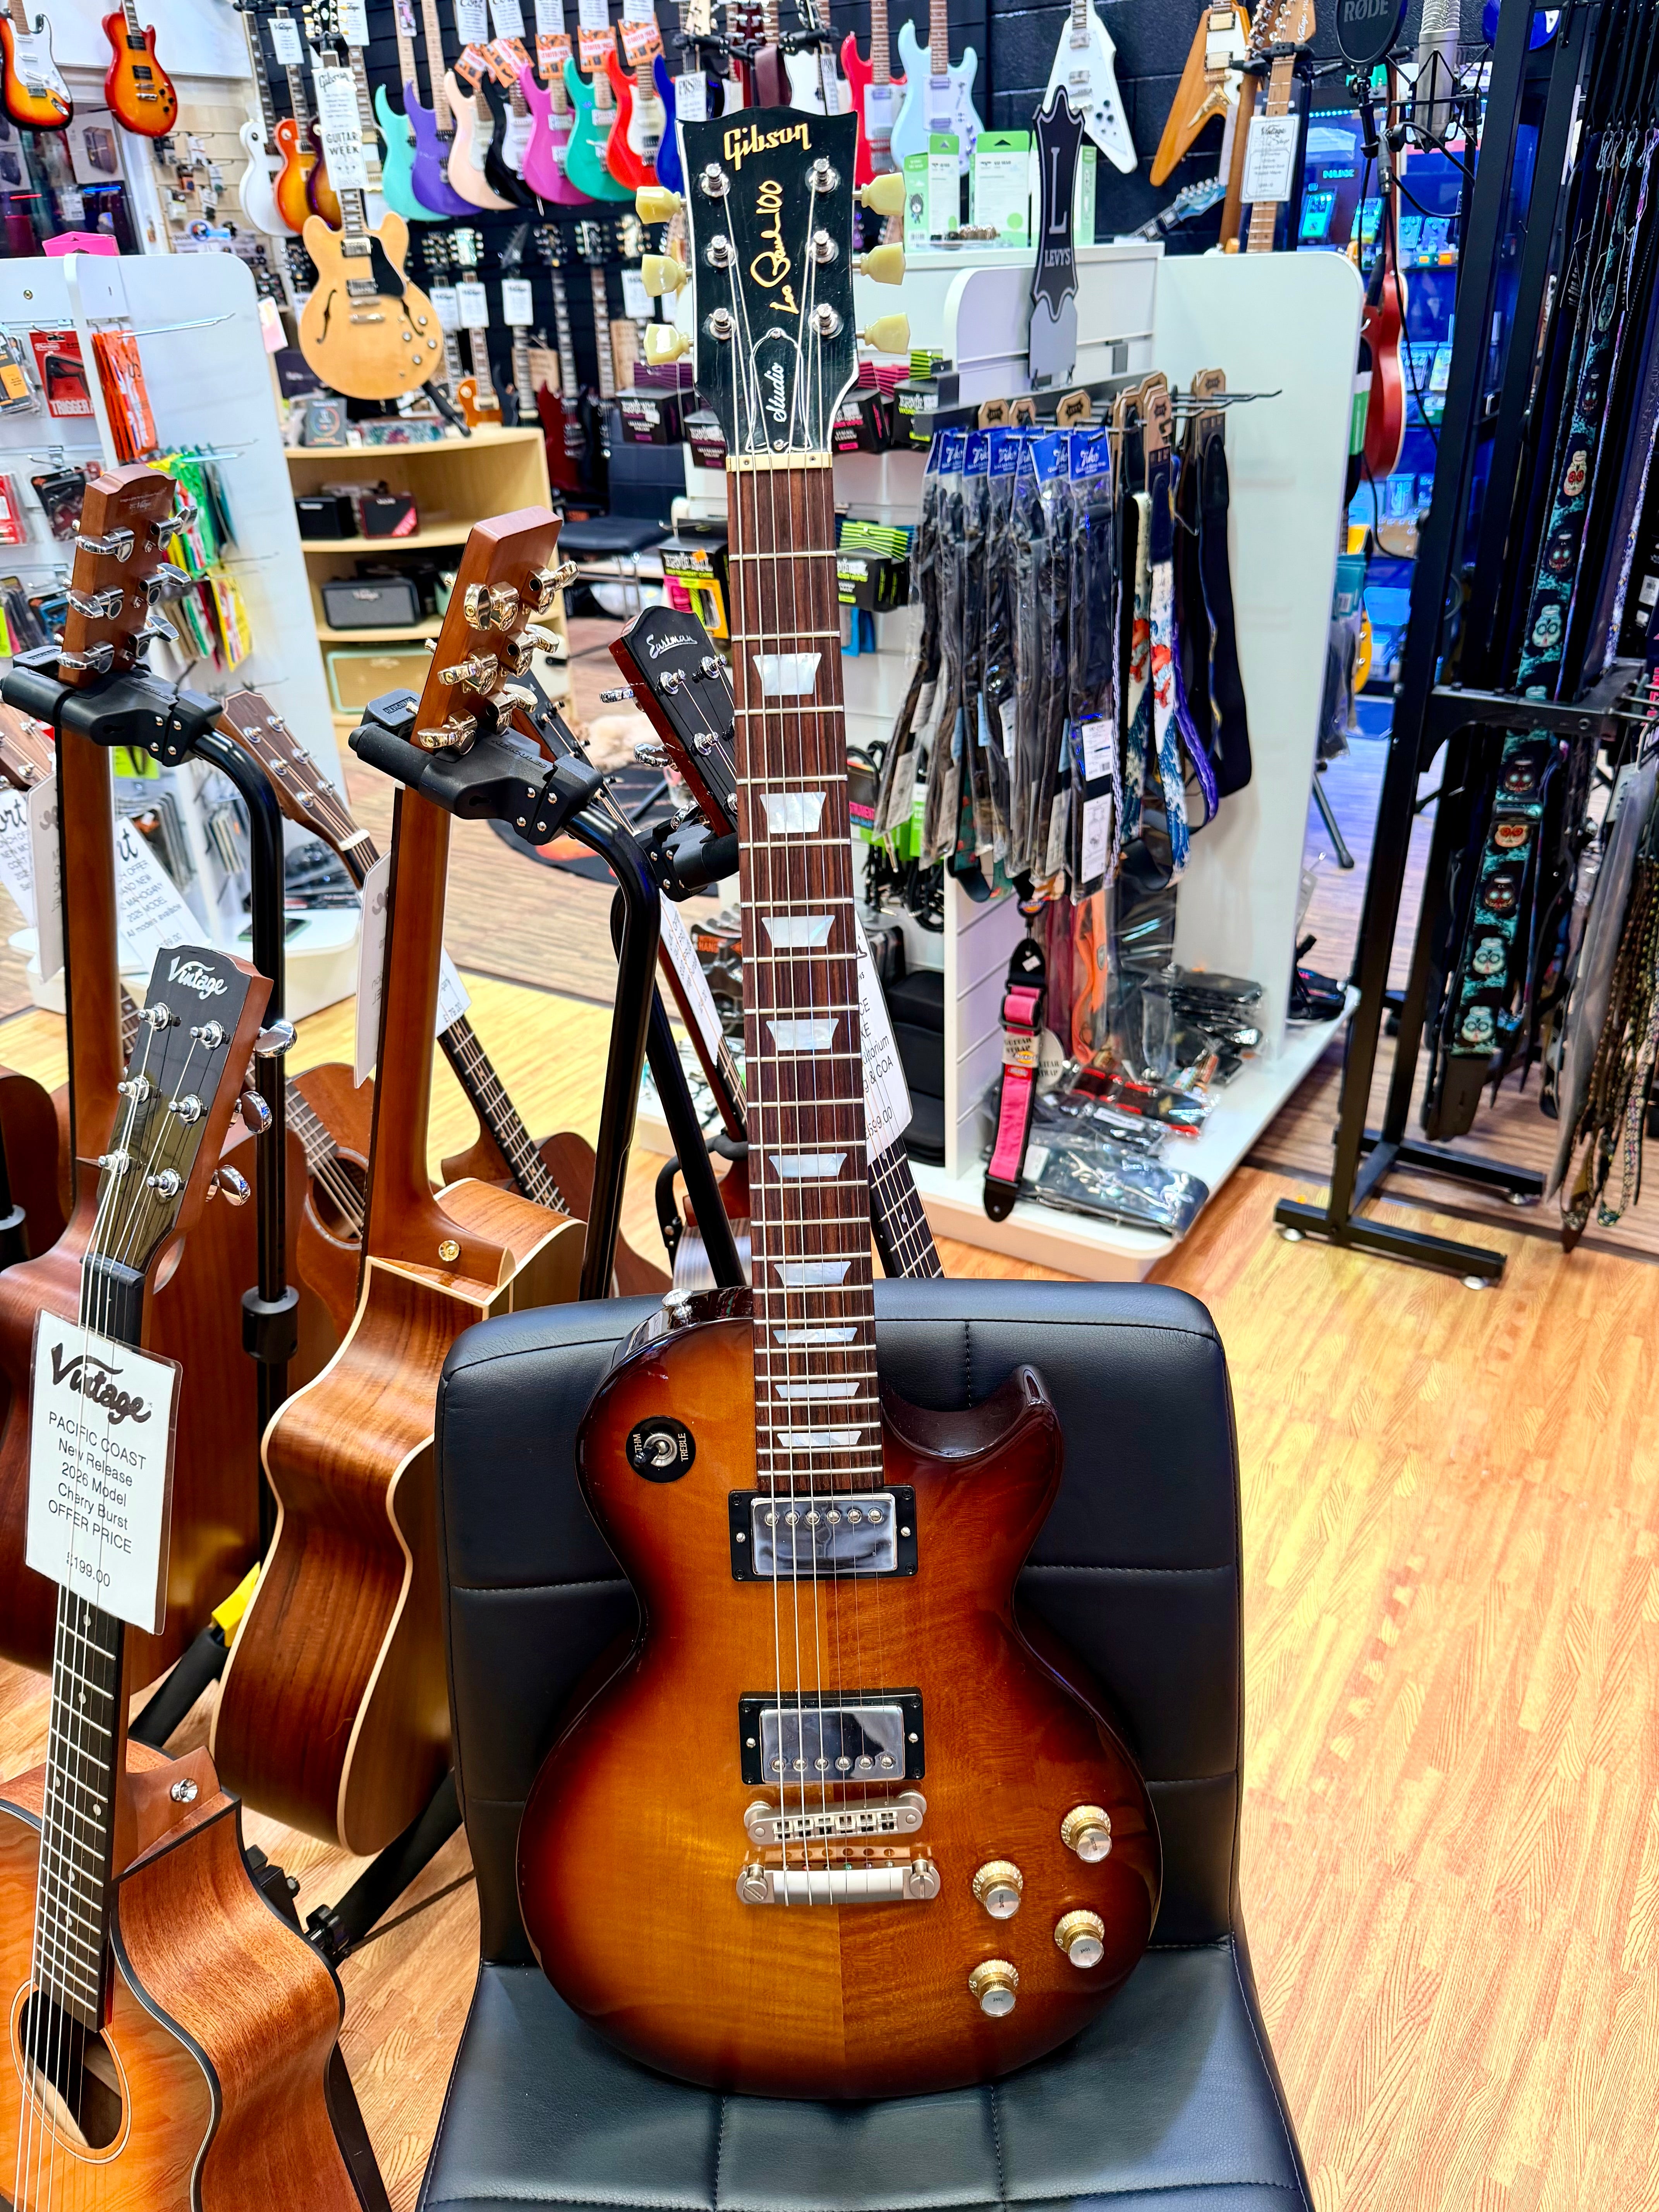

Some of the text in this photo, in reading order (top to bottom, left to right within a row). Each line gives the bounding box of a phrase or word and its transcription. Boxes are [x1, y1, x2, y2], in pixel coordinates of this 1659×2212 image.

[1344, 0, 1388, 22] RØDE
[1297, 13, 1308, 41] Vintage
[325, 132, 359, 144] GUITAR
[724, 122, 812, 170] Gibson
[750, 180, 799, 314] Les Paul 100
[765, 362, 787, 422] Studio
[898, 393, 924, 409] ERNIE
[50, 399, 89, 416] TRIGGER
[665, 568, 698, 577] INSTRUMENT
[646, 634, 698, 659] Eastman
[493, 739, 548, 768] HERCULES
[136, 873, 152, 885] NEW
[135, 917, 158, 933] models
[158, 903, 182, 921] available
[143, 896, 167, 912] MODEL
[168, 956, 228, 1000] Vintage
[1006, 1045, 1030, 1053] STRAP
[876, 1054, 894, 1078] COA
[50, 1341, 152, 1425] Vintage
[48, 1410, 147, 1470] PACIFIC COAST
[678, 1433, 689, 1462] TREBLE
[58, 1438, 133, 1487] New Release
[61, 1461, 127, 1507] 2026 Model
[57, 1482, 129, 1531] Cherry Burst
[47, 1499, 132, 1554] OFFER PRICE
[66, 1551, 111, 1587] £199.00
